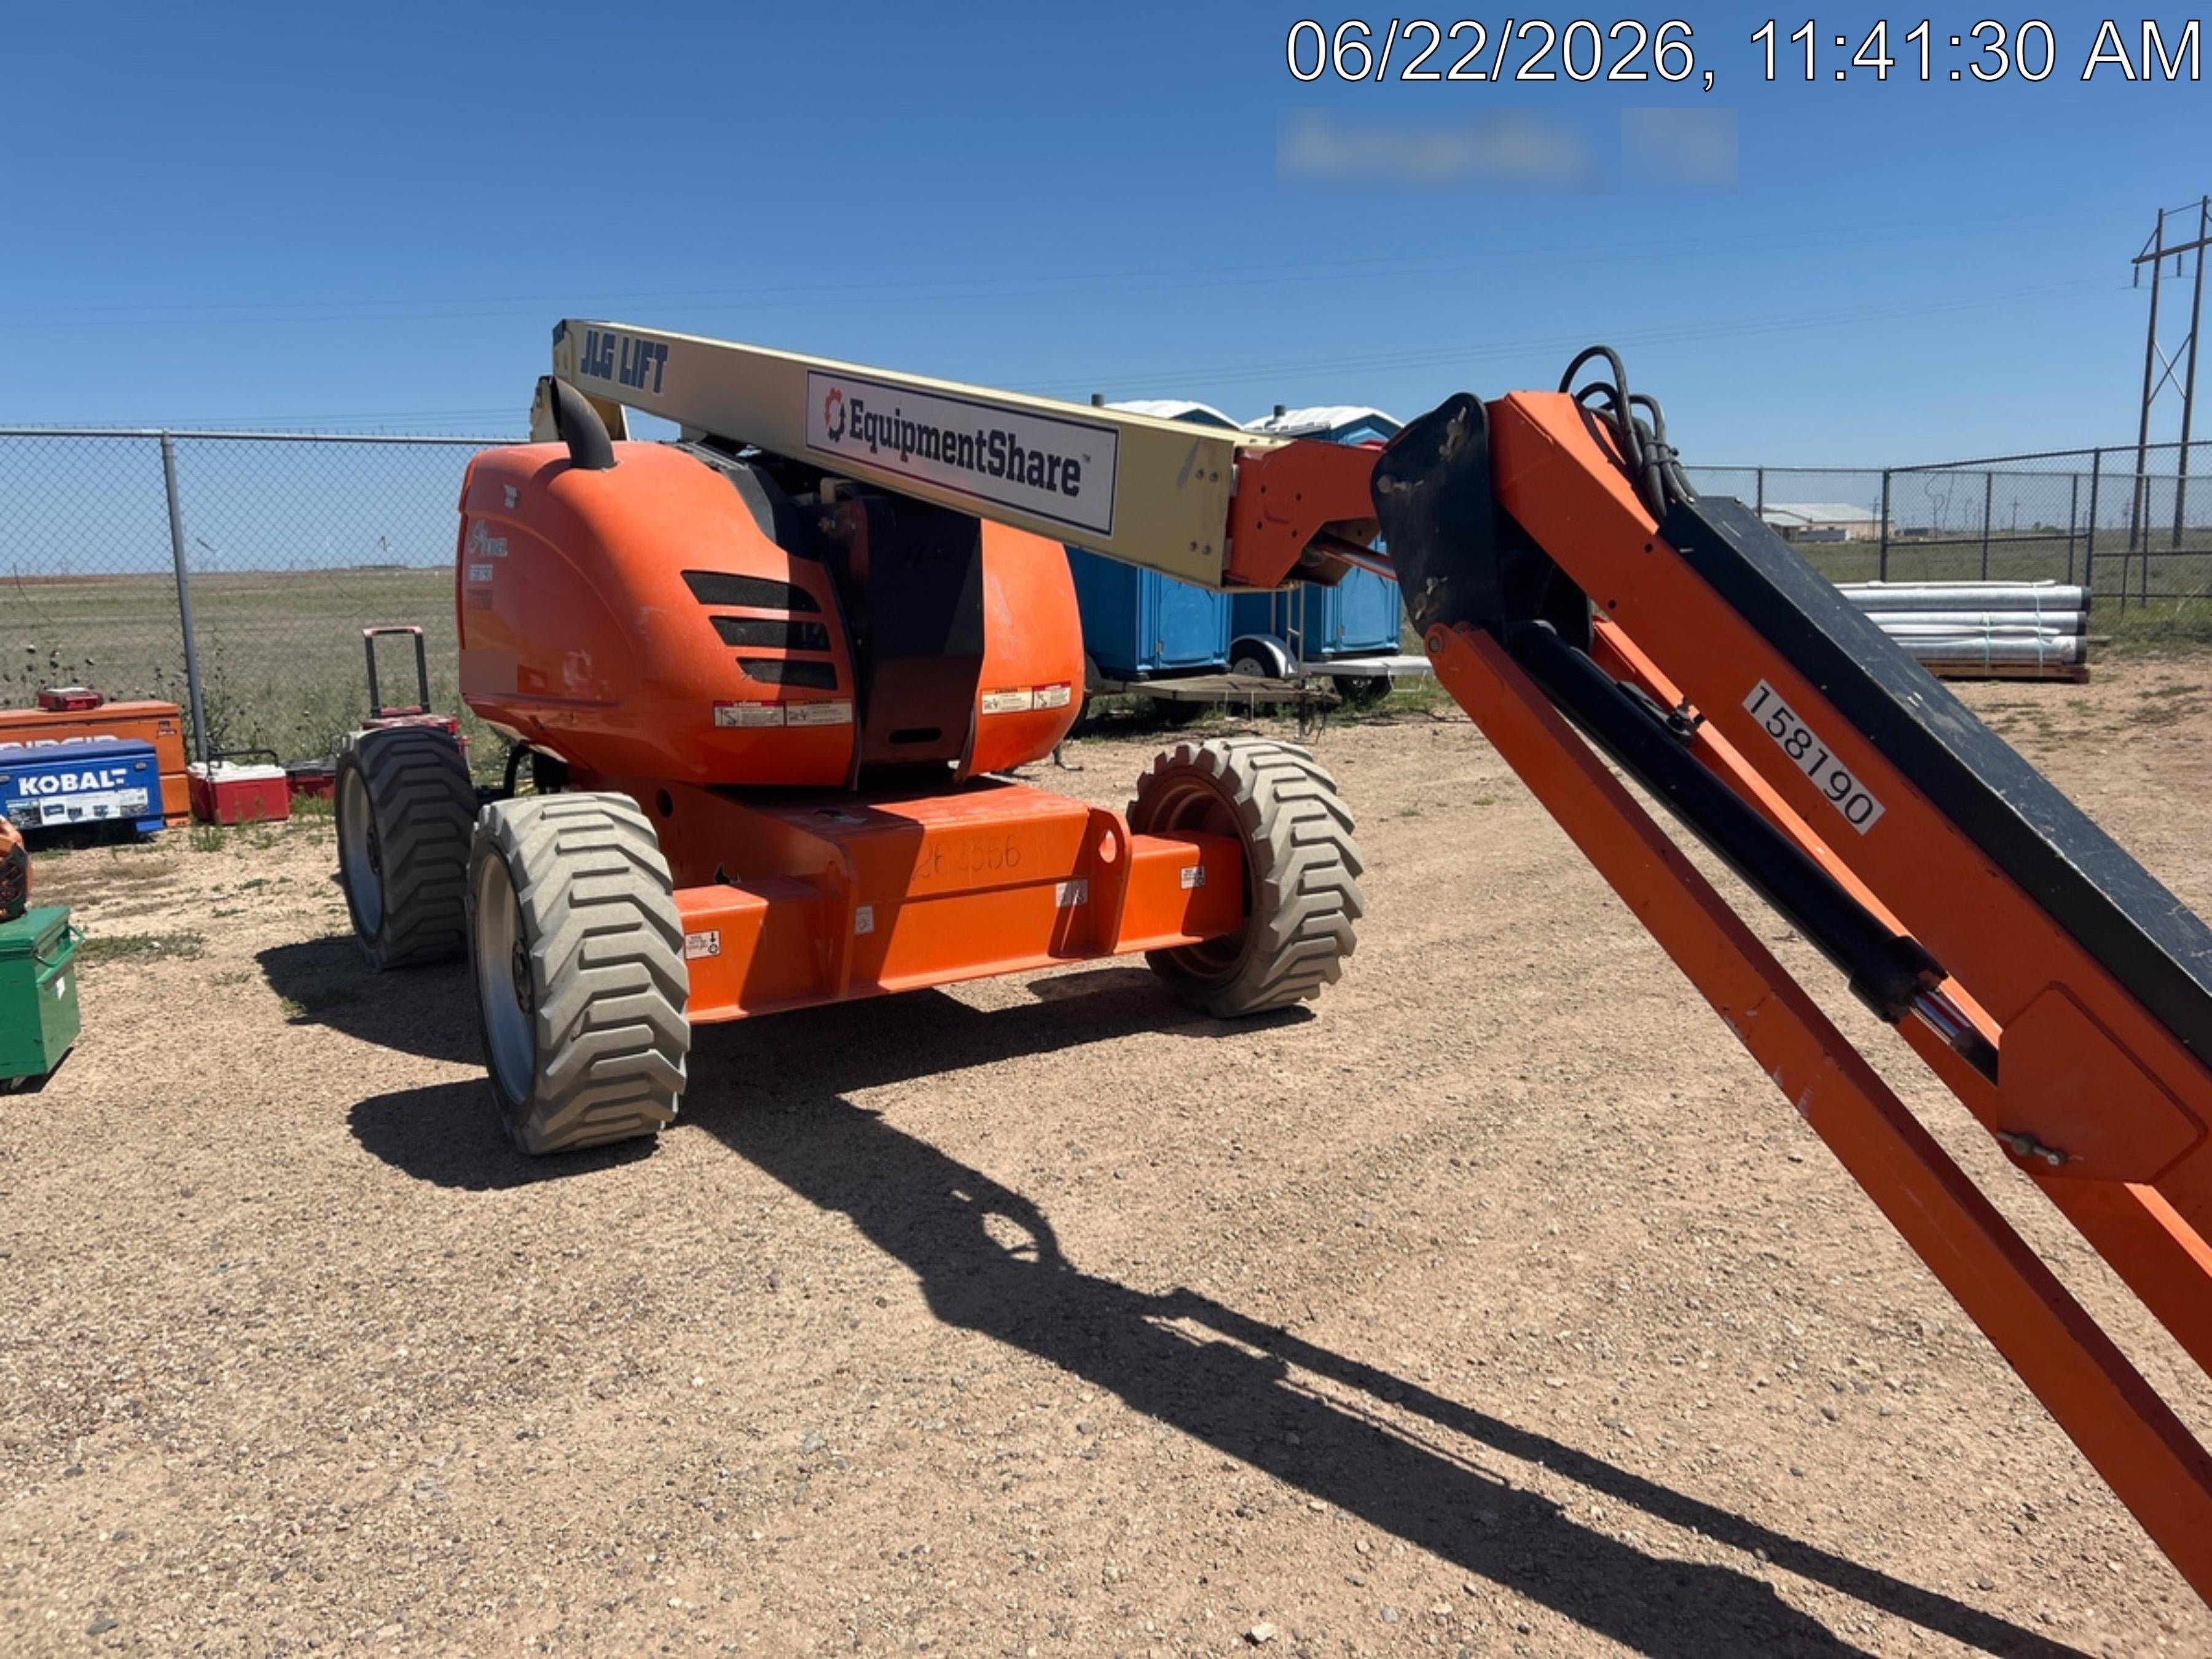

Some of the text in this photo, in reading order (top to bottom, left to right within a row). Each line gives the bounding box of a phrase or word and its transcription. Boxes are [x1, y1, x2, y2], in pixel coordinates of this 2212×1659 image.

[580, 329, 669, 394] JLG LIFT
[849, 398, 1081, 497] EquipmentShare
[18, 768, 127, 796] KOBALT
[1751, 685, 1873, 825] 158190
